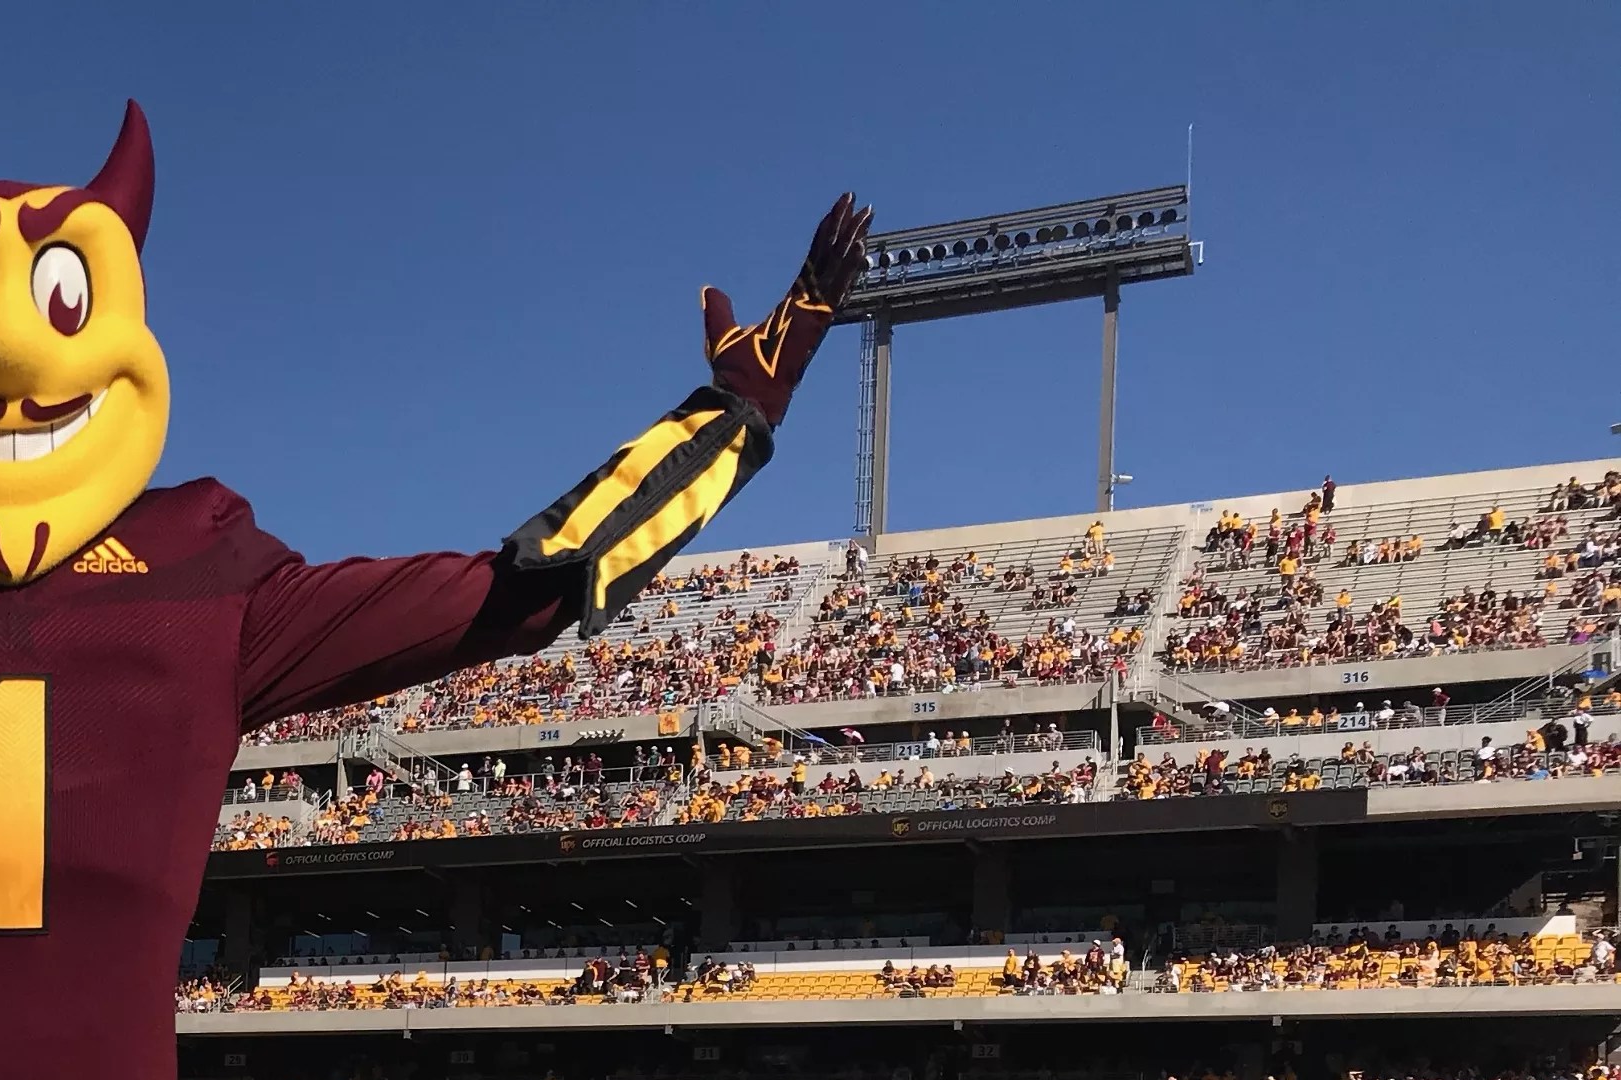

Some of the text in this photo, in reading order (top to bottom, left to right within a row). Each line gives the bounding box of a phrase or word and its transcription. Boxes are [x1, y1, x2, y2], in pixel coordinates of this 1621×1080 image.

[73, 557, 149, 574] adidas
[1343, 671, 1369, 684] 316
[914, 702, 936, 713] 315
[1339, 716, 1367, 728] 214
[540, 730, 559, 741] 314
[898, 744, 921, 757] 213
[917, 819, 964, 832] OFFICIAL
[966, 816, 1021, 829] LOGISTICS
[582, 837, 624, 849] OFFICIAL
[626, 834, 674, 846] LOGISTICS
[675, 833, 706, 844] COMP
[285, 854, 322, 865] OFFICIAL
[324, 851, 367, 863] LOGISTICS
[699, 1048, 713, 1059] 31
[978, 1045, 993, 1056] 32
